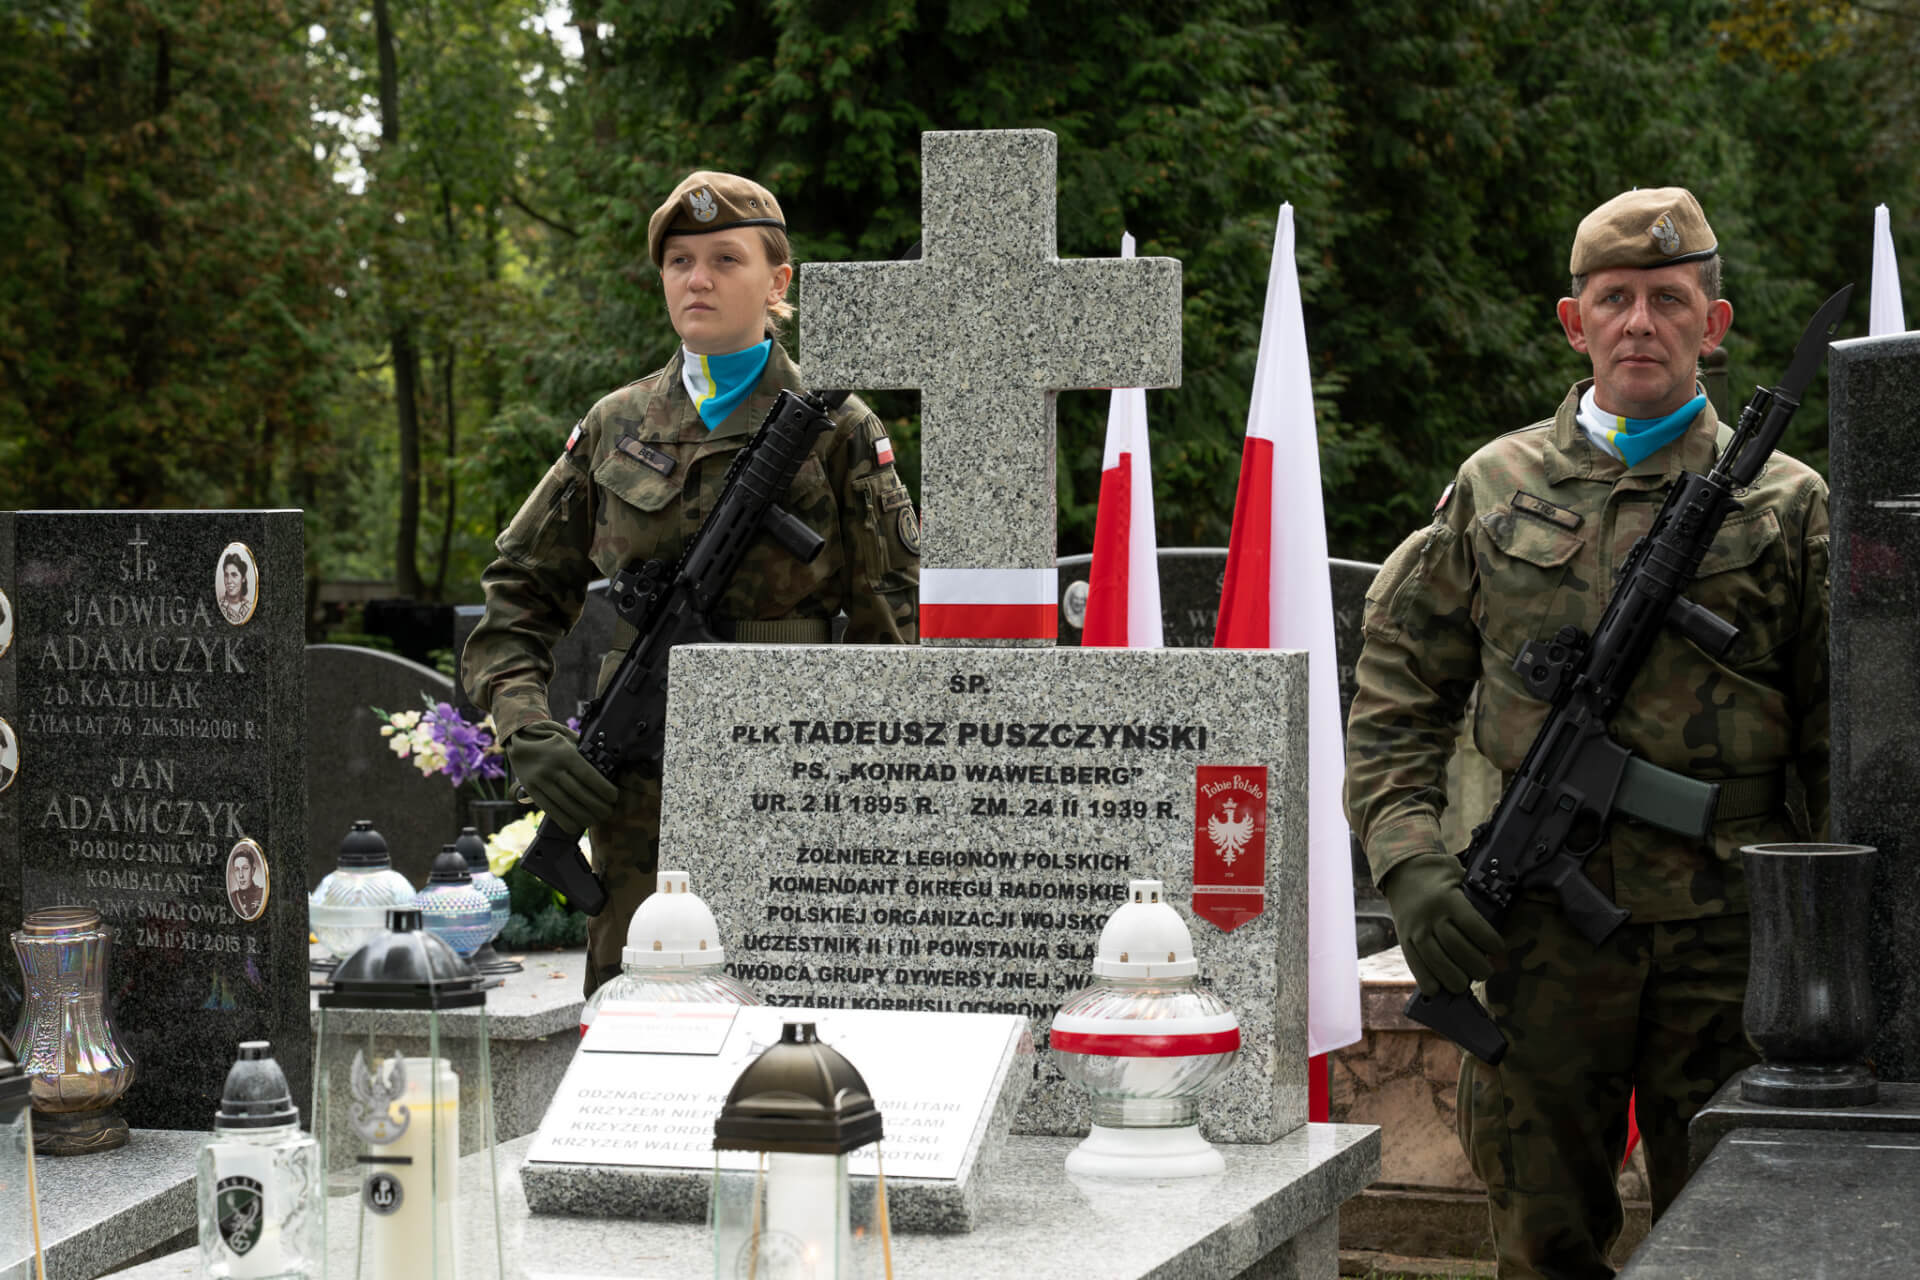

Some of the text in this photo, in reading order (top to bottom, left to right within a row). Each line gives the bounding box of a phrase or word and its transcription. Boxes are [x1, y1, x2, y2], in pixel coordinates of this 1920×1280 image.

[65, 595, 213, 628] JADWIGA
[38, 635, 246, 673] ADAMCZYK
[80, 679, 201, 709] KAZULAK
[950, 668, 991, 694] ŚP.
[76, 715, 107, 735] LAT
[112, 716, 132, 735] 78
[732, 719, 1207, 750] PŁK TADEUSZ PUSZCZYŃSKI
[111, 756, 175, 793] JAN
[792, 762, 829, 780] PS.
[1201, 780, 1232, 798] Tobie
[41, 793, 247, 839] ADAMCZYK
[751, 794, 1180, 820] UR. 2 II 1895 R. ZM. 24 II 1939 R.
[69, 839, 218, 866] PORUCZNIK WP
[906, 846, 1017, 869] LEGIONÓW
[1023, 852, 1130, 871] POLSKICH
[86, 868, 202, 896] KOMBATANT
[769, 876, 1130, 901] KOMENDANT OKRĘGU RADOMSKIE
[767, 906, 1108, 932] POLSKIEJ ORGANIZACJI WOJSKO
[744, 935, 861, 955] UCZESTNIK
[926, 940, 1049, 960] POWSTANIA
[723, 962, 812, 985] OWÓDCA
[819, 966, 889, 985] GRUPY
[895, 968, 1050, 989] DYWERSYJNEJ
[959, 1000, 1064, 1019] OCHRONY
[577, 1088, 702, 1103] ODZNACZONY
[664, 1123, 716, 1136] ORDE
[883, 1134, 941, 1146] OLSKI
[887, 1116, 946, 1129] CZAMI
